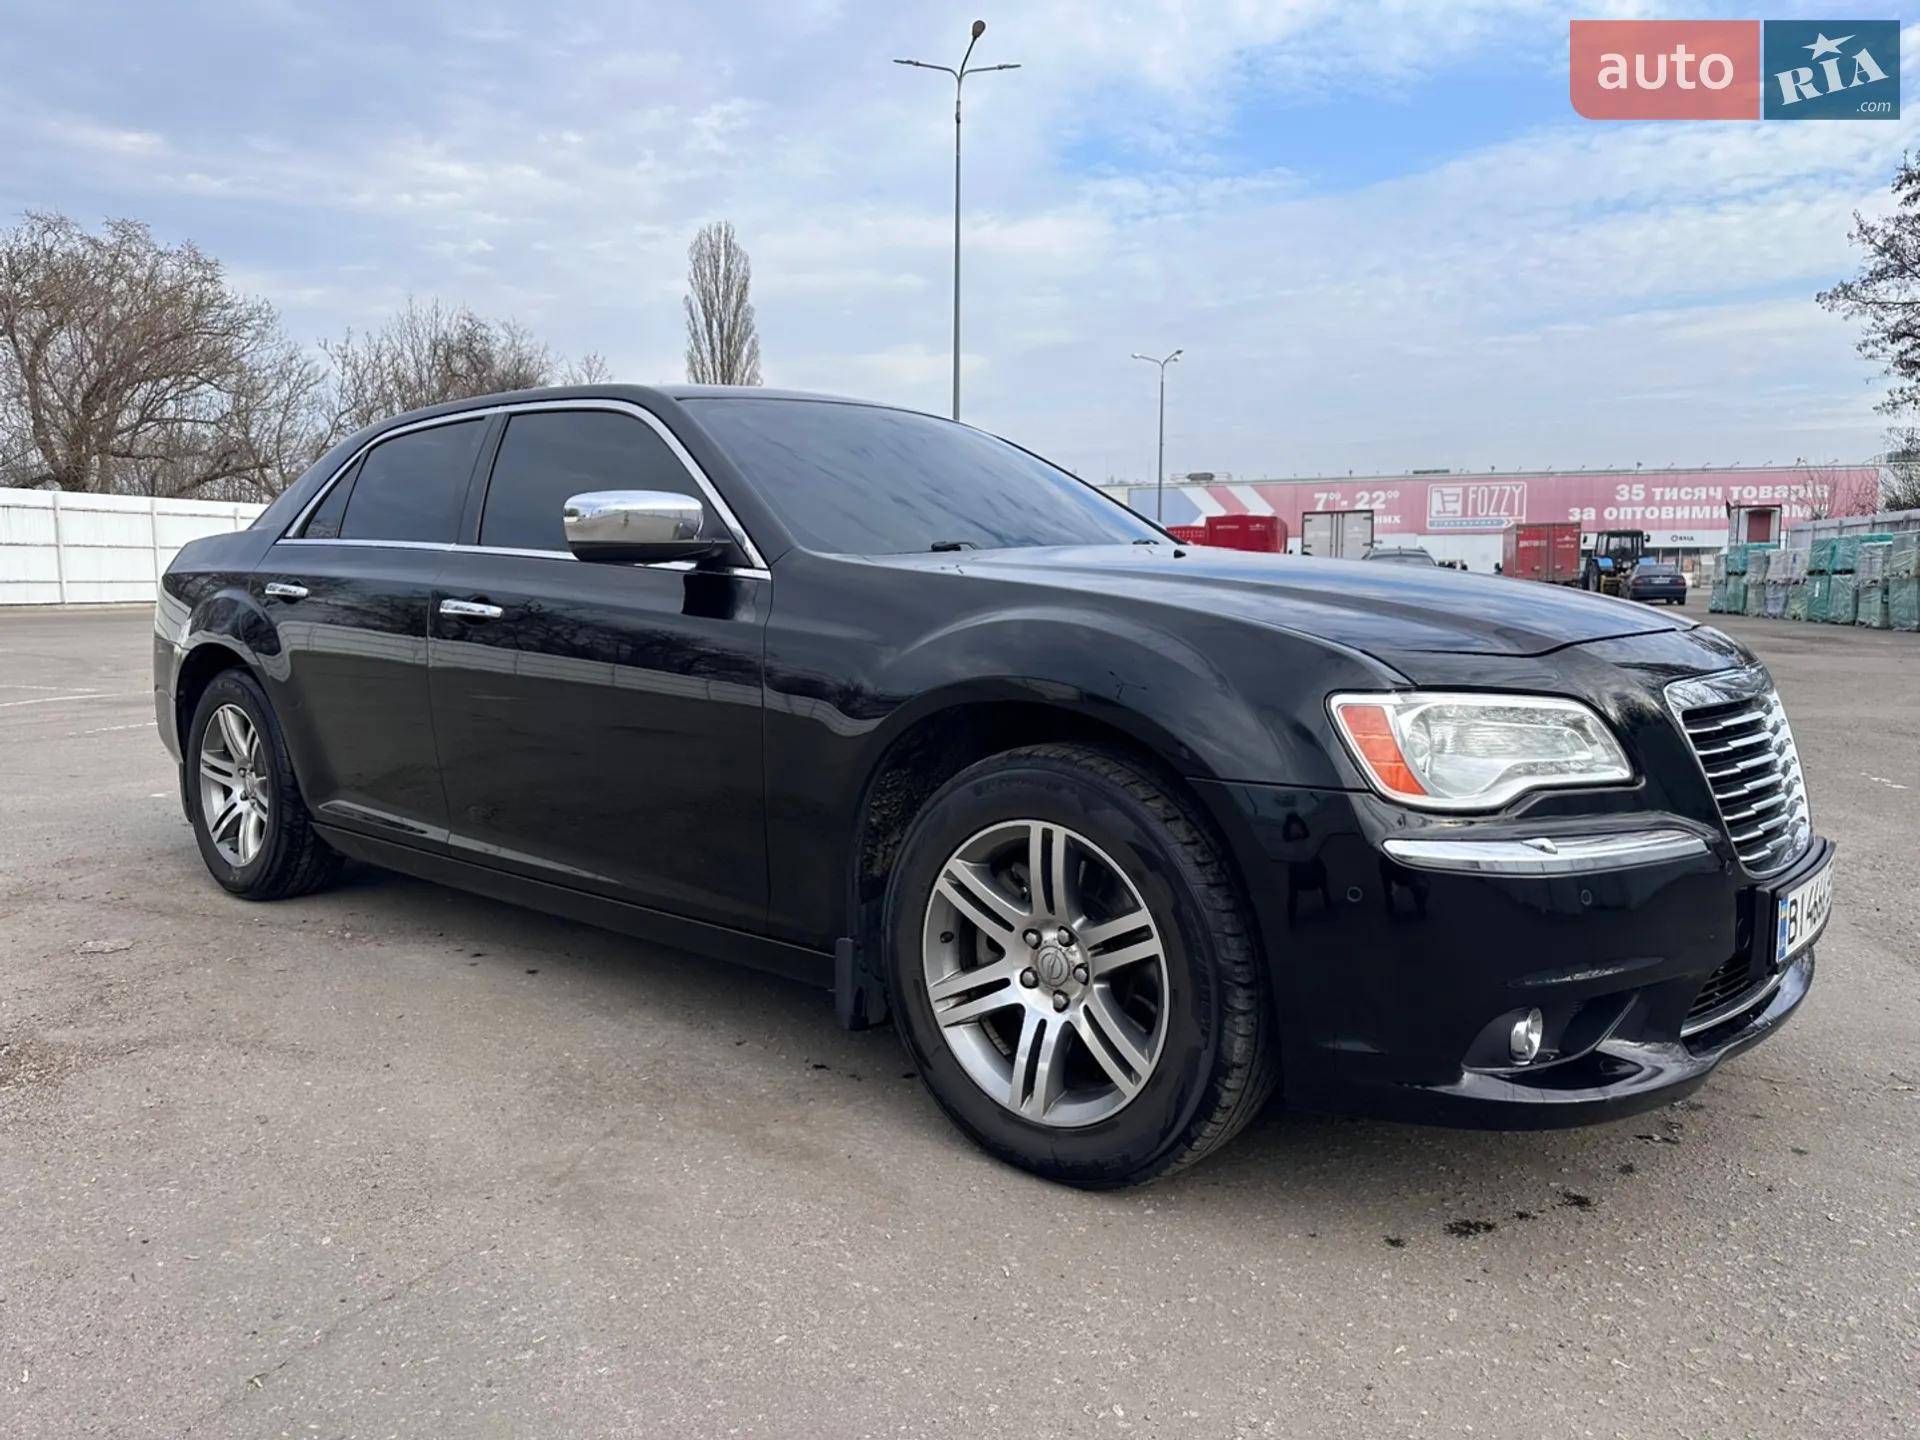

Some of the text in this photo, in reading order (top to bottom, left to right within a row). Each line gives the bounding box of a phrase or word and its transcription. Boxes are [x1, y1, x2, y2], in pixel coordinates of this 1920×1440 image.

[1468, 485, 1523, 516] FOZZY
[1615, 484, 1645, 501] 35
[1652, 485, 1722, 501] тисяч
[1568, 507, 1596, 521] за
[1604, 504, 1727, 521] оптовими
